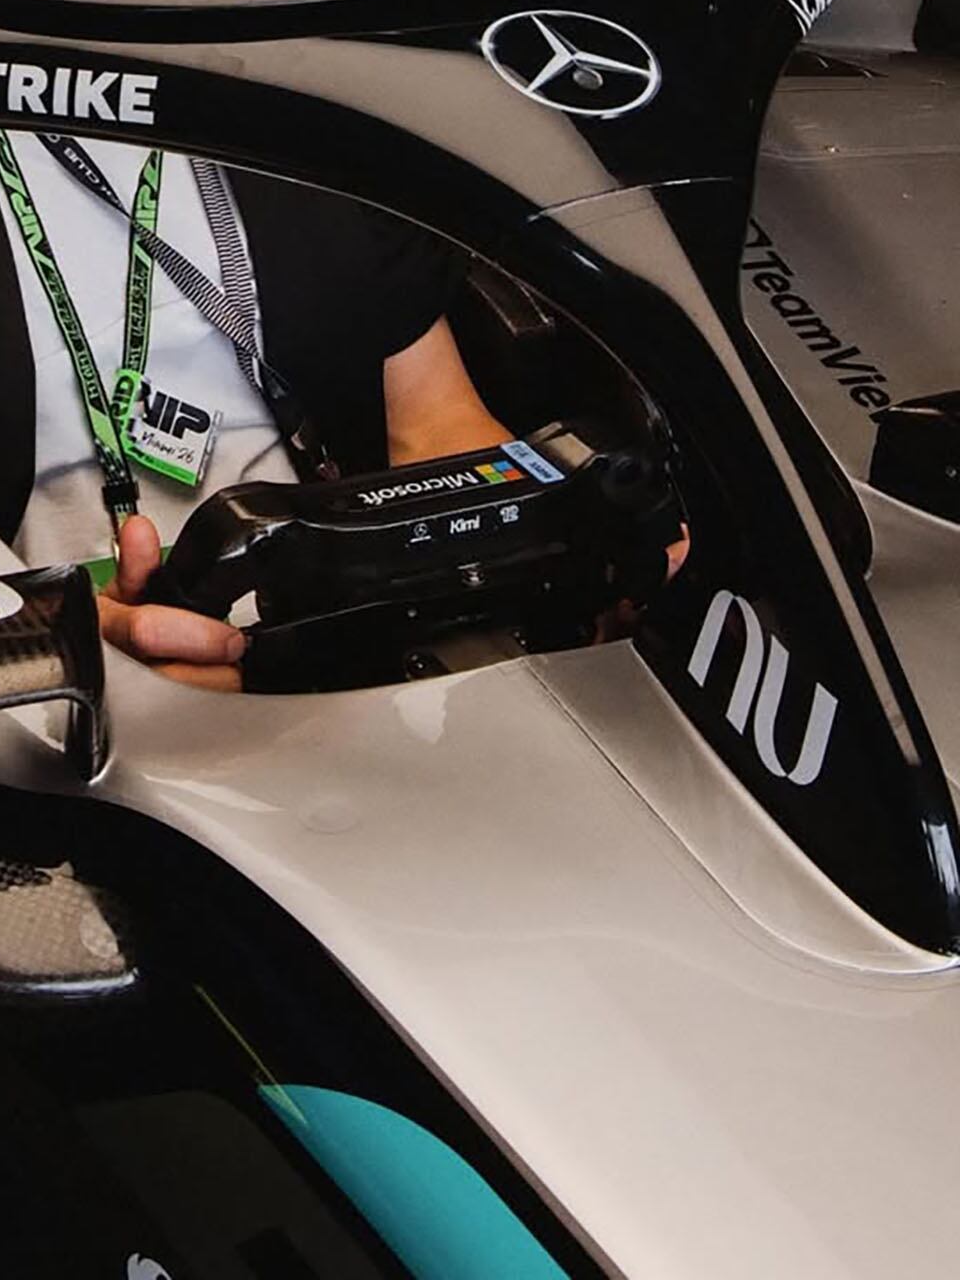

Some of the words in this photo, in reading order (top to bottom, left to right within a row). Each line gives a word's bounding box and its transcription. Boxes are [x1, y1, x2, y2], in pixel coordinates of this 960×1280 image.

[741, 251, 890, 423] TeamVie
[141, 380, 211, 440] VIP
[358, 471, 479, 505] Microsoft
[450, 515, 480, 534] Kimi
